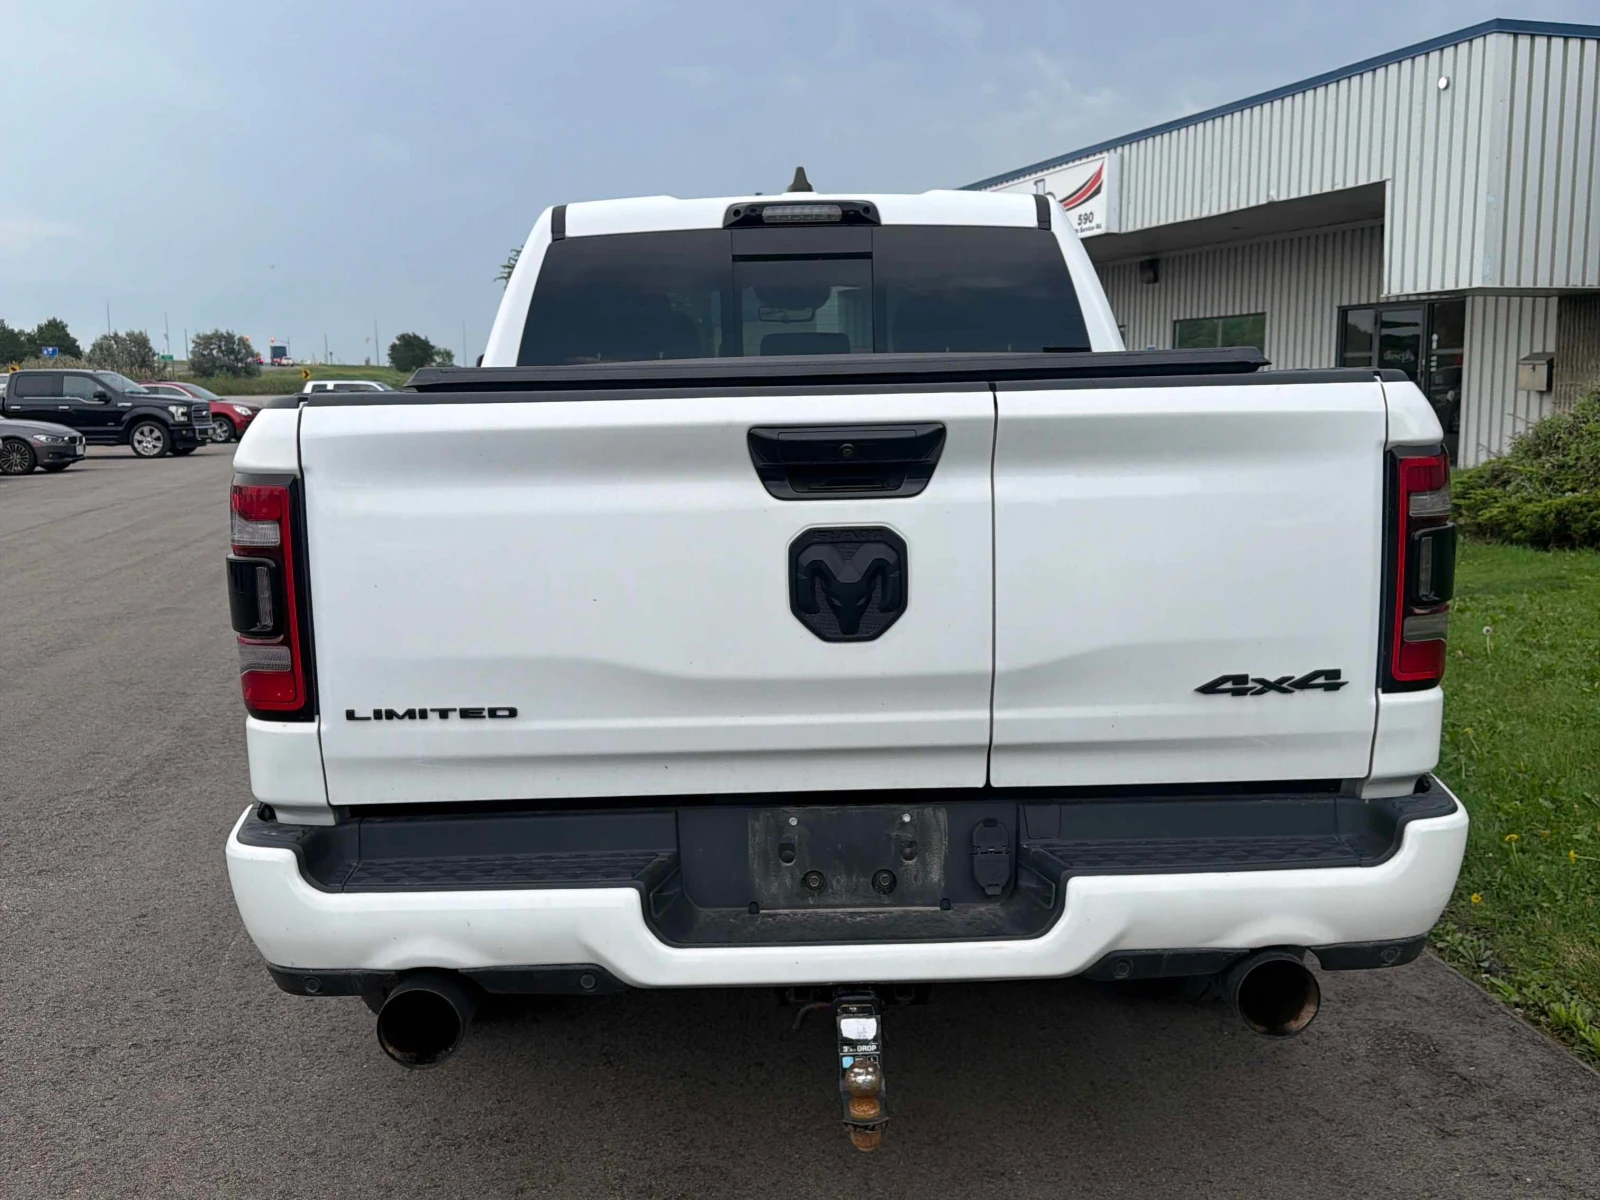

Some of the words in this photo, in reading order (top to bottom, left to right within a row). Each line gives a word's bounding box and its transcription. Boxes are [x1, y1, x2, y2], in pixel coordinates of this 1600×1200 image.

[1077, 211, 1094, 226] 590
[813, 530, 883, 542] RAM
[345, 706, 518, 721] LIMITED
